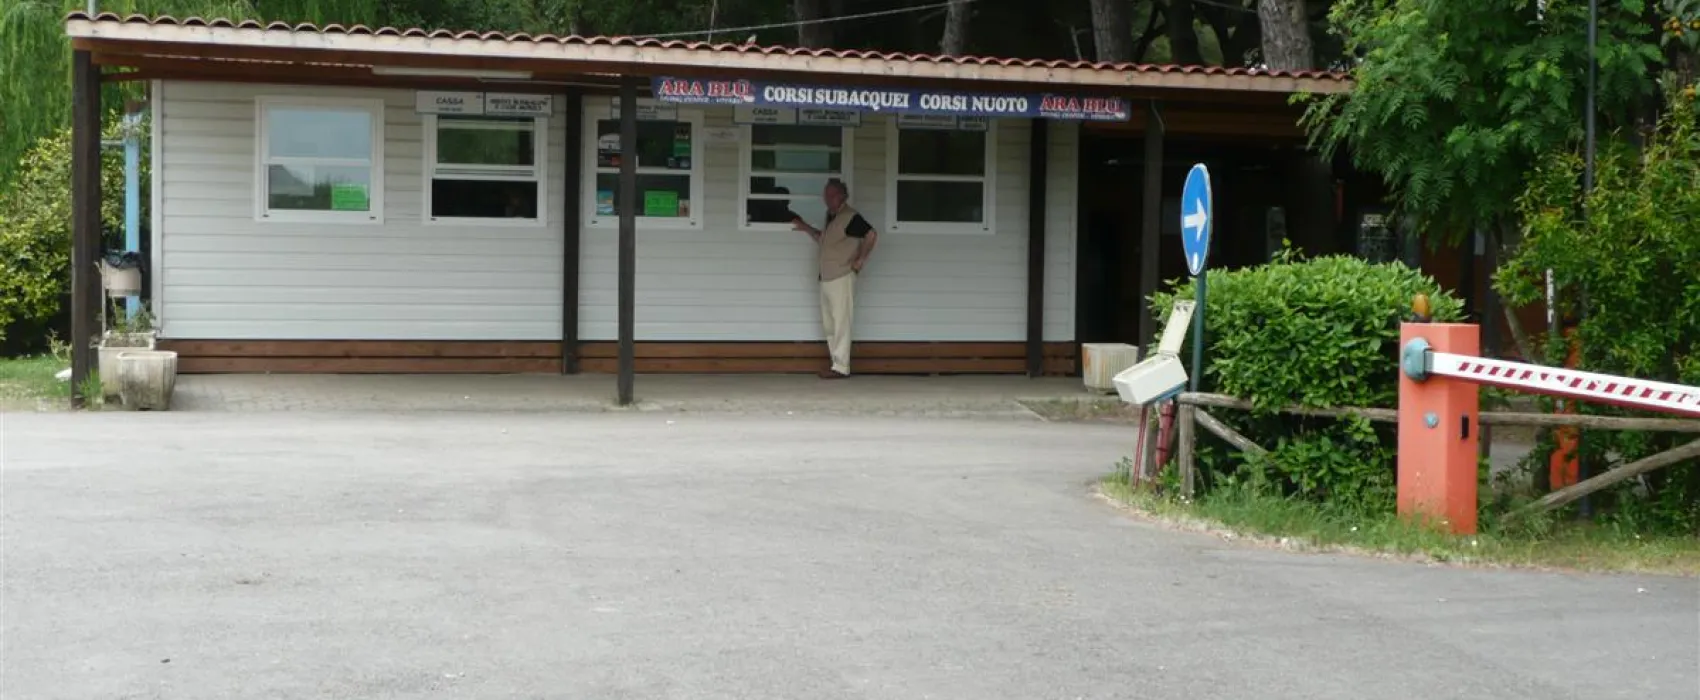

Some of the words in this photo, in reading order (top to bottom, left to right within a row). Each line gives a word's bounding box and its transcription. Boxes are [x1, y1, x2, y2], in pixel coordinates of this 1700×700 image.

[659, 80, 704, 96] ARA
[435, 96, 464, 105] CASSA
[764, 85, 813, 103] CORSI
[815, 88, 909, 111] SUBACQUEI
[920, 93, 968, 111] CORSI
[971, 96, 1028, 112] NUOTO
[1040, 95, 1080, 111] ARA
